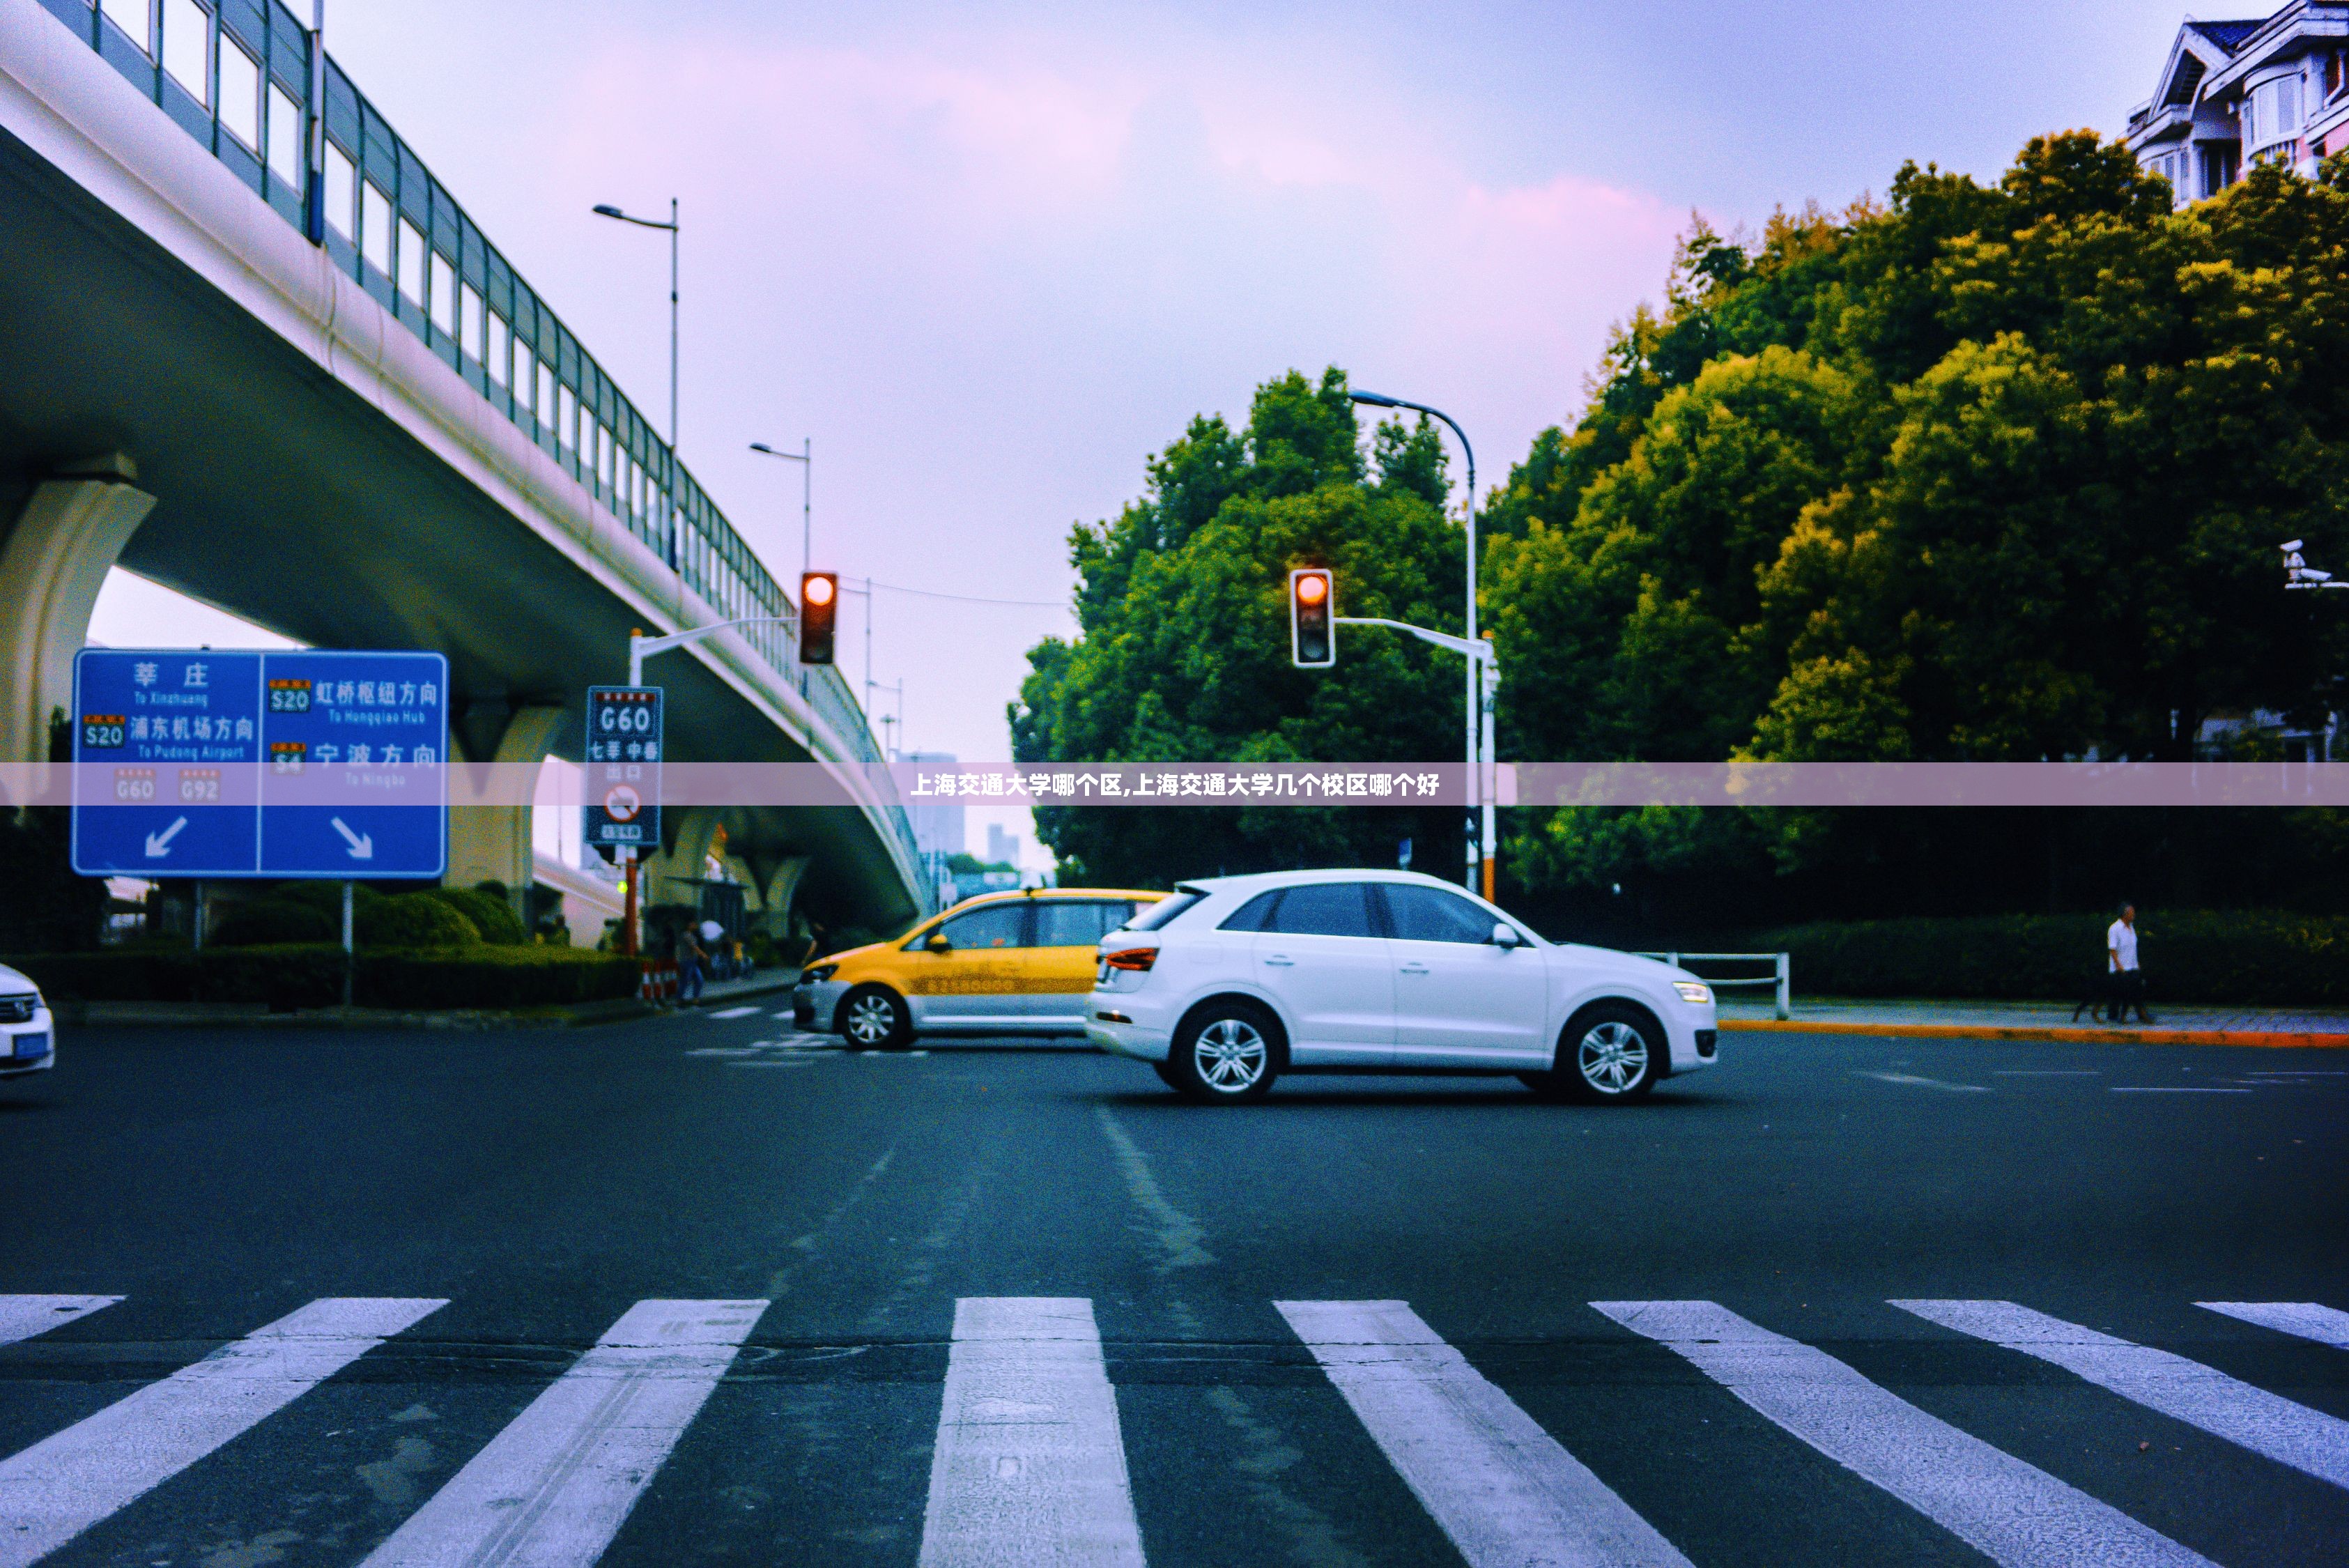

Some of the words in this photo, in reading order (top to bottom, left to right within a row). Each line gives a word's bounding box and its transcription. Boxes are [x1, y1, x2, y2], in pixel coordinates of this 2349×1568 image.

[134, 691, 146, 706] To
[272, 689, 309, 712] S20
[316, 680, 437, 706] 虹桥枢纽方向
[329, 709, 341, 724] To
[345, 709, 399, 726] Hongqiao
[403, 709, 426, 725] Hub
[601, 707, 649, 731] G60
[85, 725, 123, 746] S20
[130, 716, 254, 741] 浦东机场方向
[139, 744, 151, 759] To
[155, 744, 199, 761] Pudong
[201, 745, 244, 760] Airport
[315, 743, 436, 769] 宁波方向
[275, 753, 302, 775] S4
[116, 780, 155, 800] G60
[181, 780, 219, 801] G92
[346, 772, 358, 786] To
[362, 772, 406, 788] Ningbo
